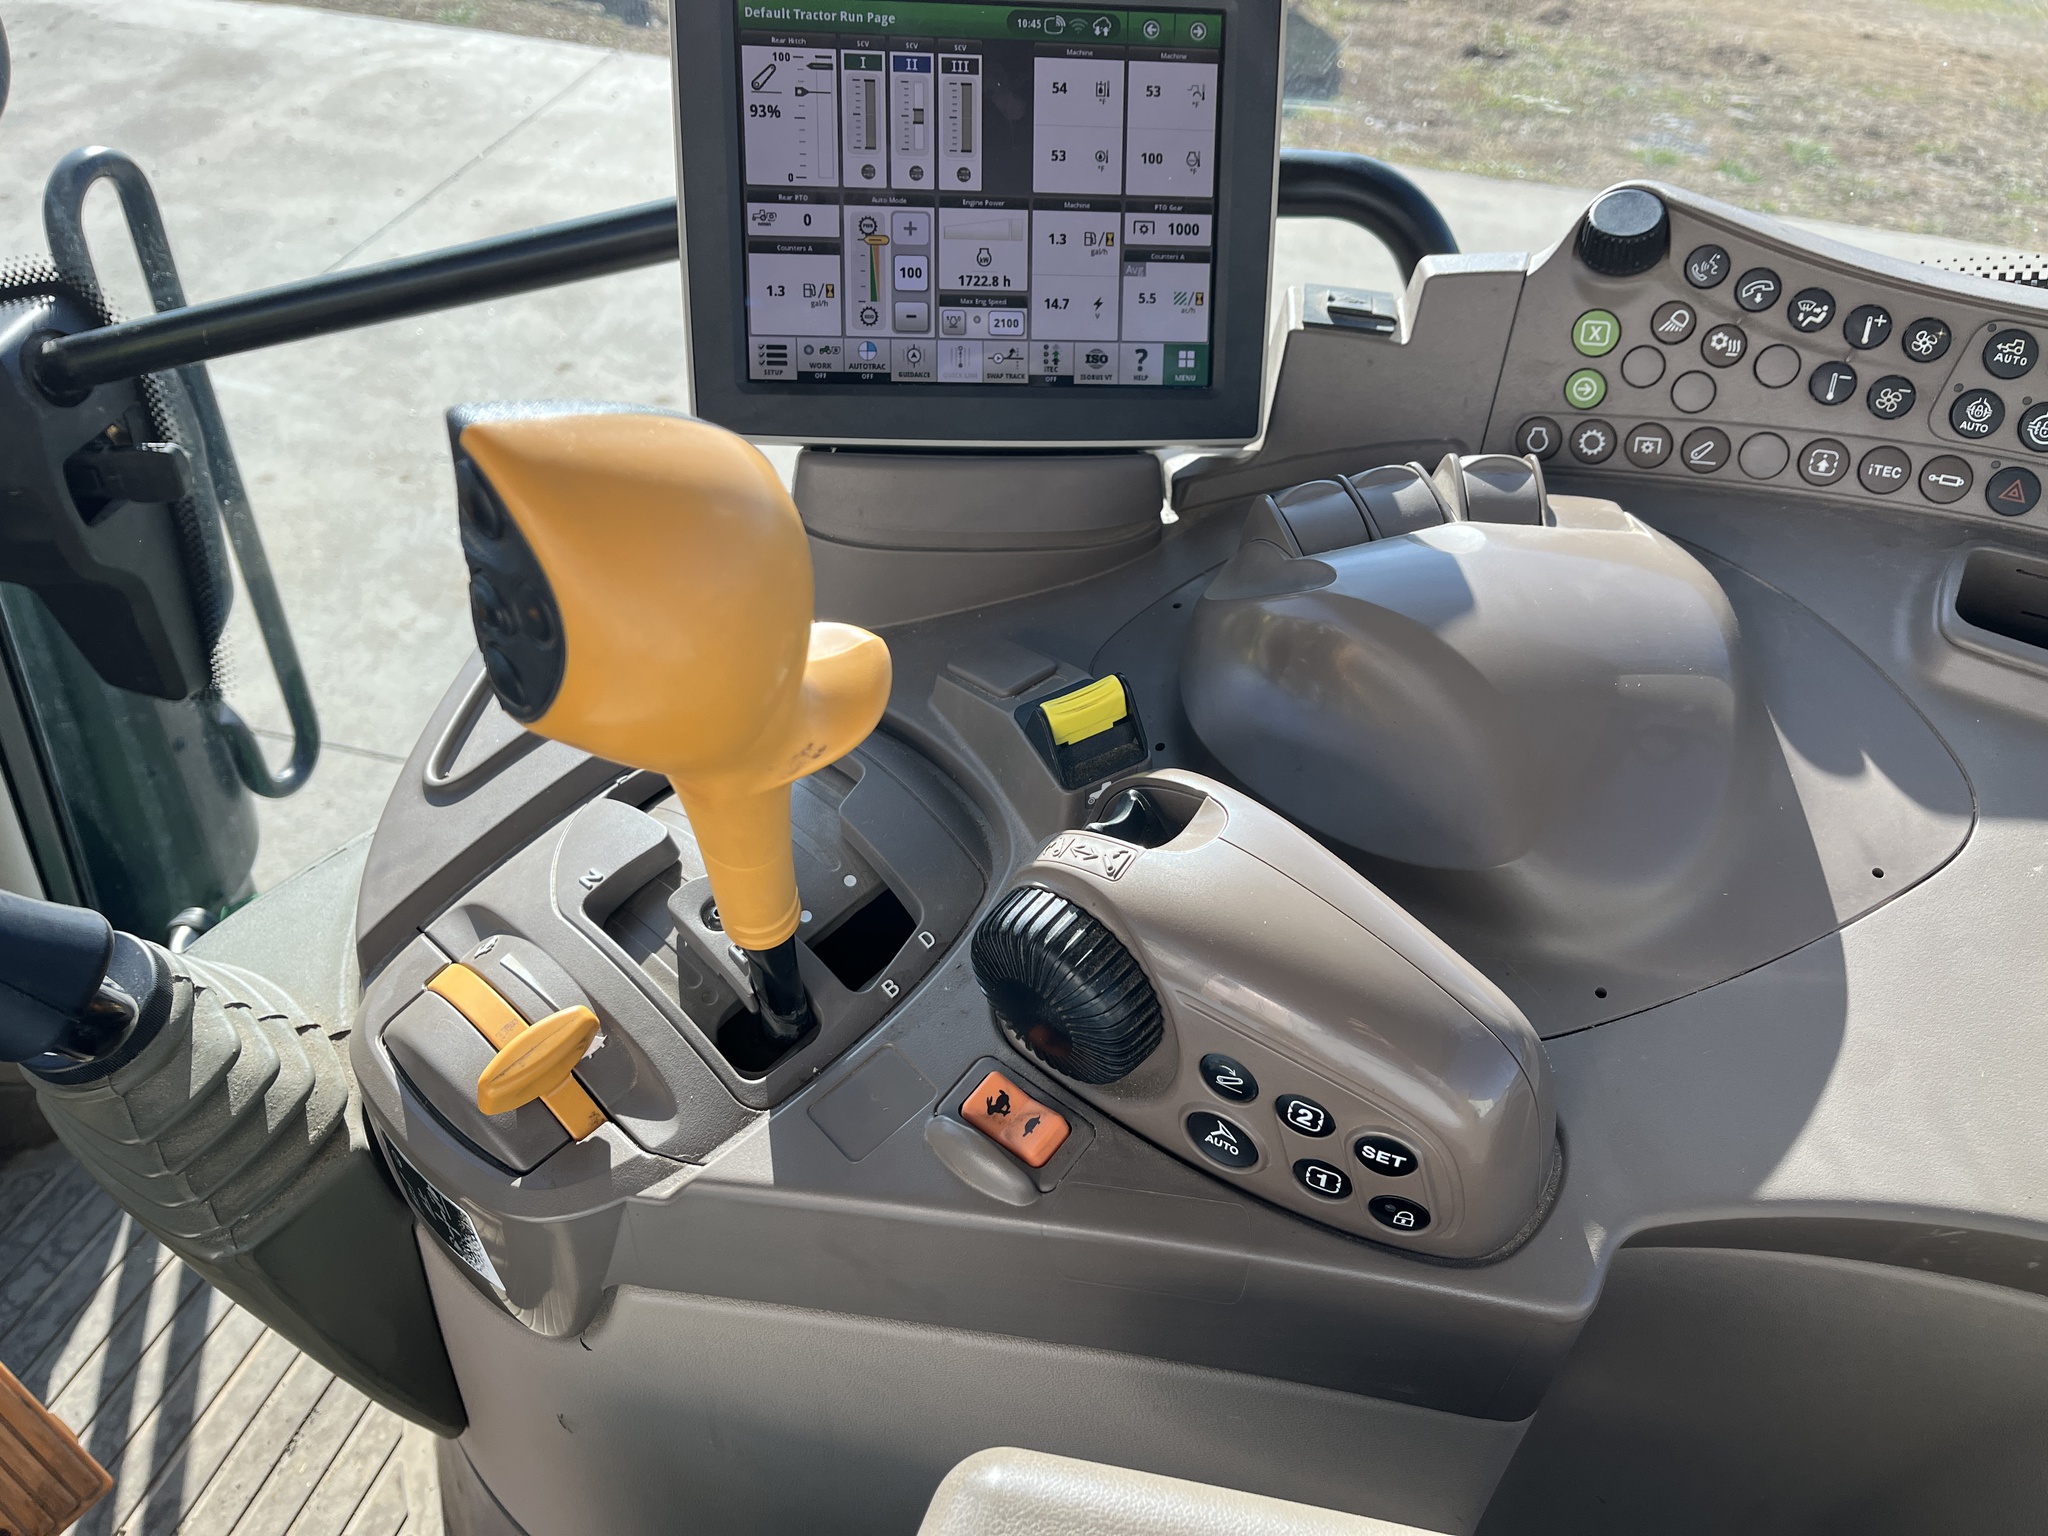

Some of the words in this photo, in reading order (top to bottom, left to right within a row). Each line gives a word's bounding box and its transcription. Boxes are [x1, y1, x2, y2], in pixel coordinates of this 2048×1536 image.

[744, 6, 791, 19] Default
[793, 8, 837, 21] Tractor
[840, 10, 864, 22] Run
[867, 12, 896, 27] Page
[1017, 18, 1042, 29] 10:45
[771, 36, 786, 44] Rear
[788, 36, 807, 45] Hitch
[905, 42, 919, 50] SCV
[772, 52, 791, 62] 100
[1066, 48, 1094, 56] Machine
[1160, 52, 1188, 60] Machine
[905, 58, 919, 71] II
[951, 60, 970, 73] III
[1052, 81, 1068, 95] 54
[1145, 85, 1161, 98] 53
[750, 104, 781, 119] 93%
[1051, 150, 1067, 162] 53
[1141, 152, 1163, 165] 100
[788, 173, 794, 182] 0
[962, 198, 983, 207] Engine
[985, 199, 1005, 207] Power
[1169, 204, 1183, 212] Gear
[803, 213, 812, 227] 0
[1168, 223, 1200, 236] 1000
[1048, 233, 1067, 245] 1.3
[1090, 248, 1108, 257] gal/h
[899, 267, 922, 279] 100
[1126, 265, 1144, 277] Avg
[958, 275, 999, 287] 1722.8
[1003, 275, 1011, 287] h
[766, 285, 785, 297] 1.3
[975, 298, 987, 307] Eng
[1044, 298, 1070, 310] 14.7
[1138, 292, 1157, 304] 5.5
[810, 300, 829, 309] gal/h
[994, 318, 1019, 328] 2100
[1085, 354, 1108, 364] ISO
[1993, 352, 2028, 367] AUTO
[809, 361, 832, 370] WORK
[848, 362, 886, 371] AUTOTRAC
[898, 371, 931, 379] GUIDANCE
[1959, 420, 1989, 434] AUTO
[1868, 463, 1902, 479] iTEC
[918, 931, 936, 949] D
[881, 979, 900, 999] B
[1296, 1108, 1313, 1127] 2
[1204, 1134, 1239, 1156] AUTO
[1361, 1145, 1407, 1168] SET
[1316, 1173, 1328, 1188] 1
